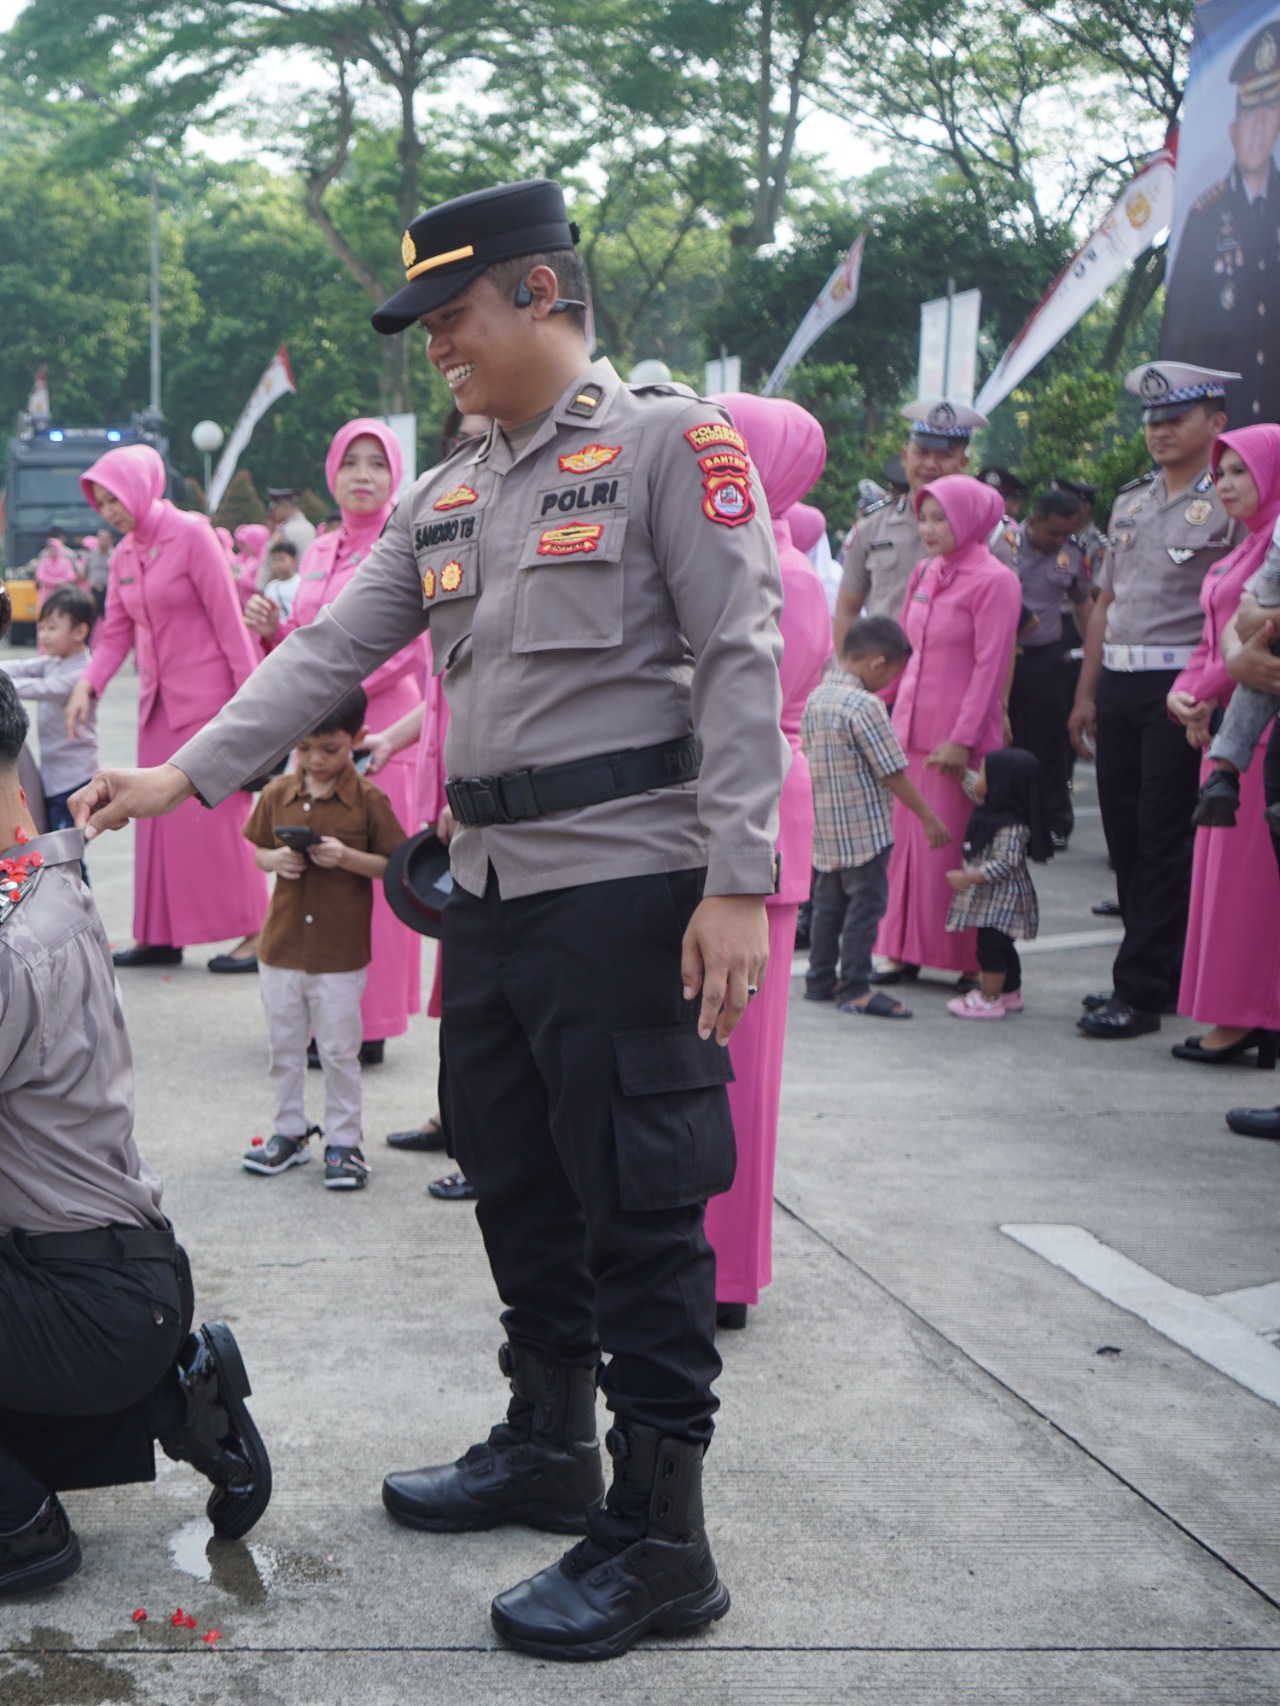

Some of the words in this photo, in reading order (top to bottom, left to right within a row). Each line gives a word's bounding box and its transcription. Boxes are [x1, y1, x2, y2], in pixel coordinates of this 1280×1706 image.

[704, 455, 746, 468] BANTEN
[541, 480, 619, 516] POLRI
[415, 519, 459, 551] SANDRO
[460, 516, 476, 539] TB
